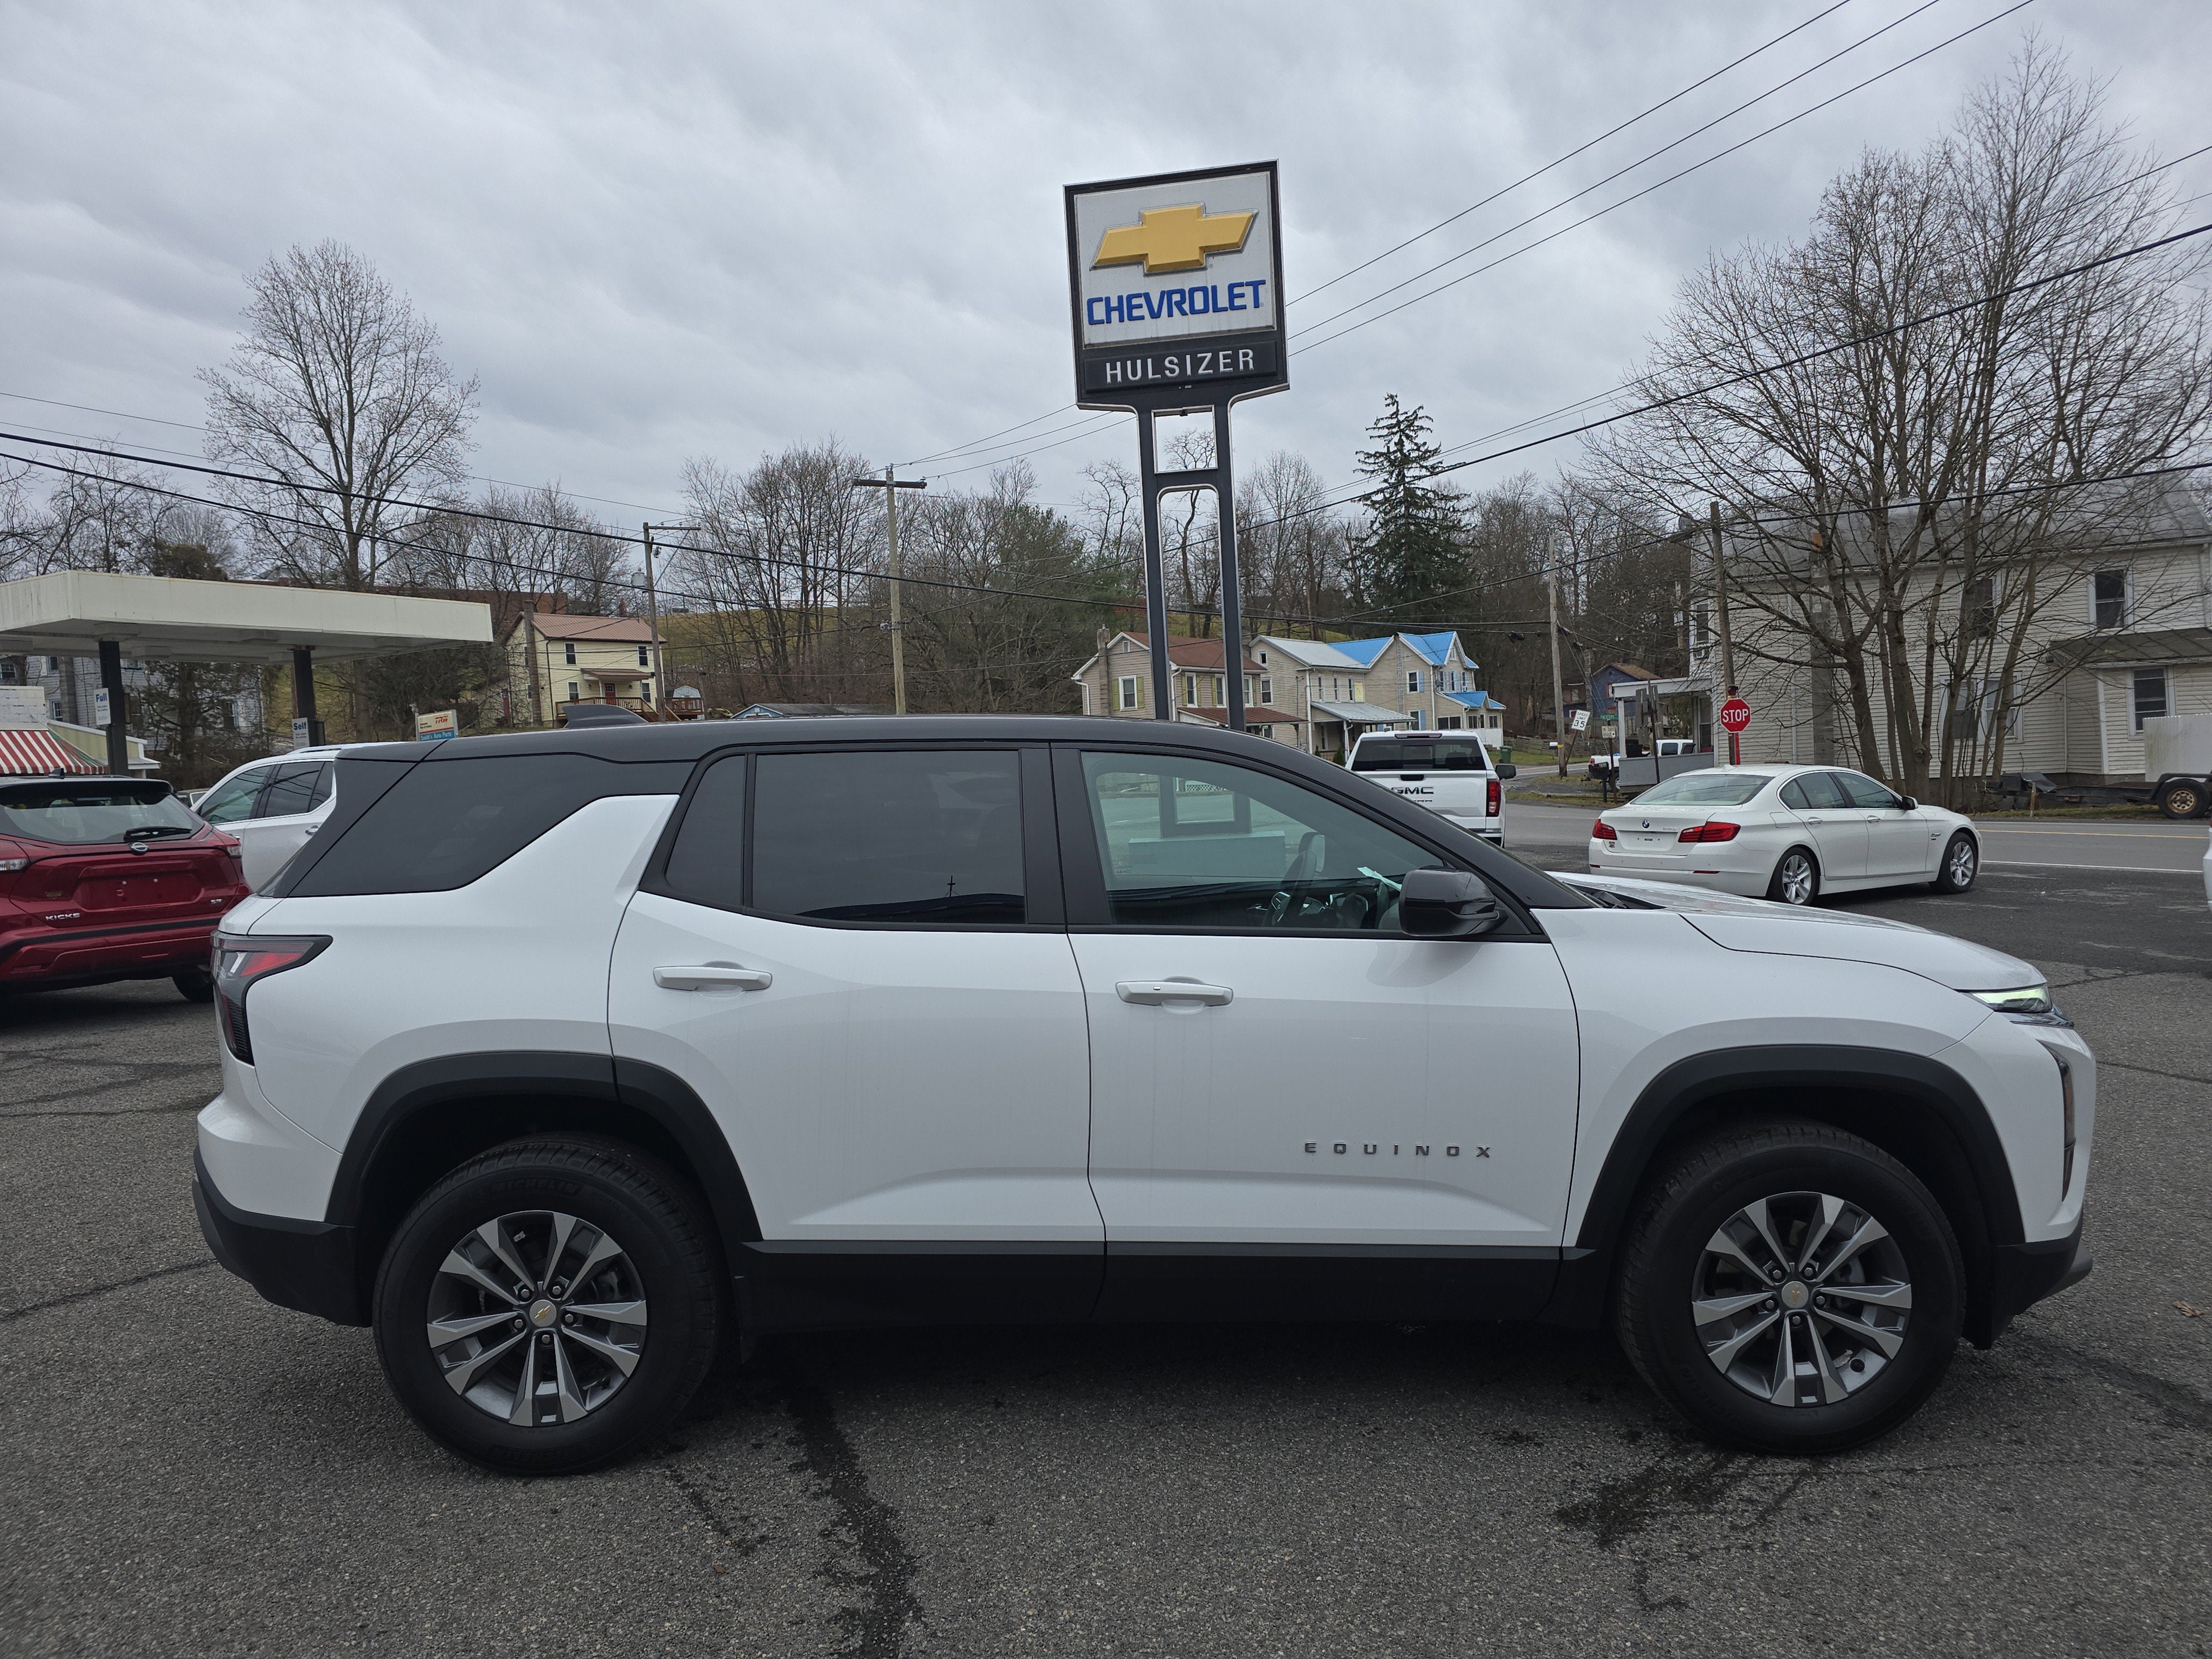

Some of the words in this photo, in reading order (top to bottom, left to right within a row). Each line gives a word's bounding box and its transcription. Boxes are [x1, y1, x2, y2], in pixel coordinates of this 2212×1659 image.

[1086, 279, 1266, 325] CHEVROLET
[1105, 349, 1255, 384] HULSIZER
[95, 692, 107, 702] Full
[1722, 709, 1748, 723] STOP
[293, 722, 306, 730] Self
[1574, 720, 1585, 728] 35
[1391, 787, 1434, 795] GMC
[45, 912, 80, 921] KICKS
[1304, 1141, 1490, 1159] EQUINOX
